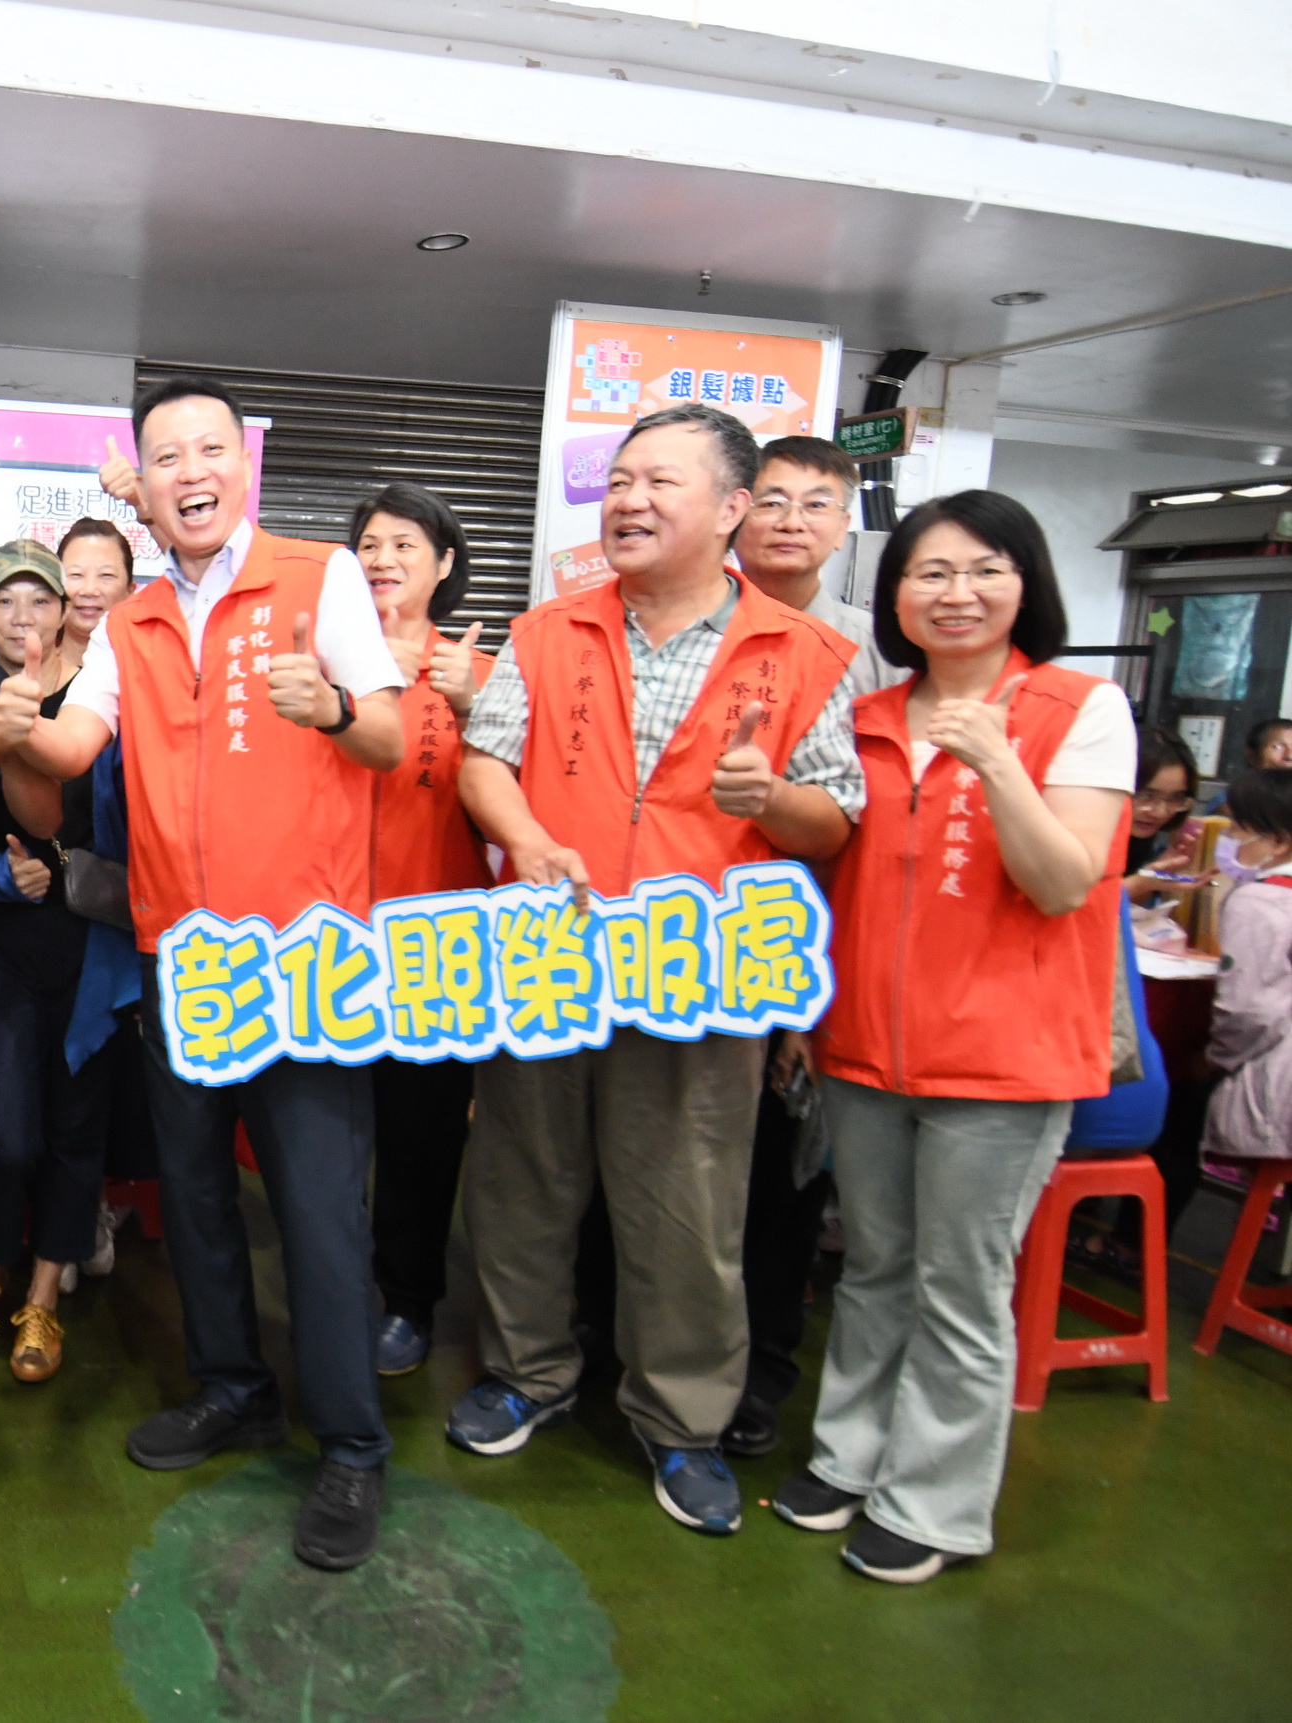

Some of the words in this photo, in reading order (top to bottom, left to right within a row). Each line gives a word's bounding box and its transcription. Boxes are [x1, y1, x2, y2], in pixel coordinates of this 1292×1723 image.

[669, 370, 784, 405] 銀髮據點
[170, 881, 816, 1066] 彰化縣榮服處
